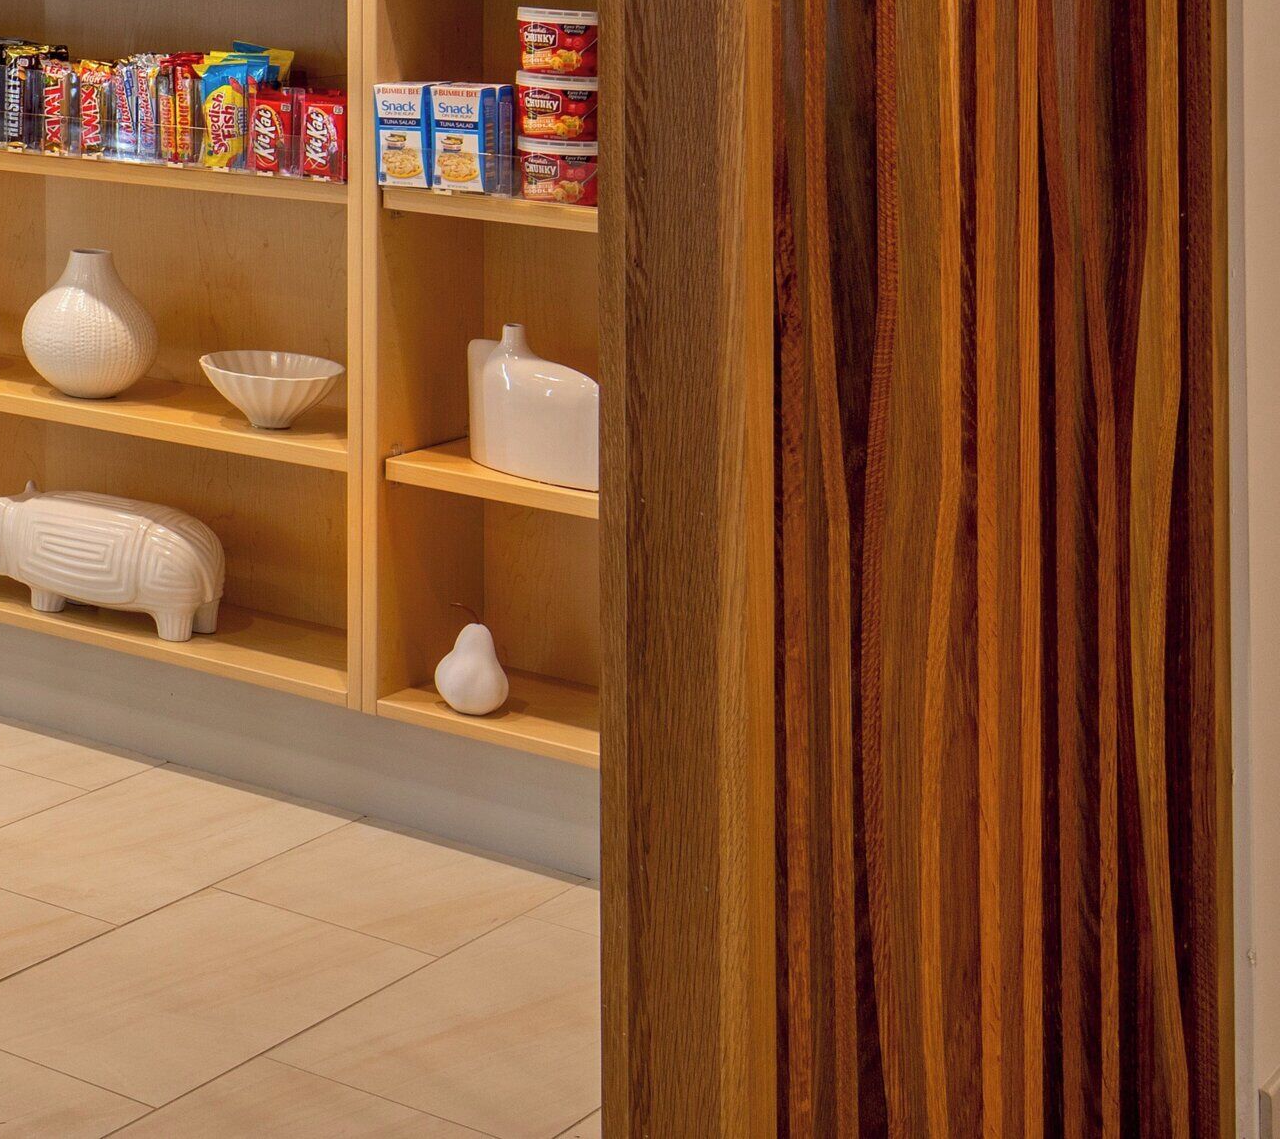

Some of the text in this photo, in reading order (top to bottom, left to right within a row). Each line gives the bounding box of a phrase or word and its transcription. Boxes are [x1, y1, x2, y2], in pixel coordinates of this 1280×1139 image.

[524, 32, 556, 45] CHUNKY
[381, 87, 420, 96] BUMBLE BEE
[438, 89, 478, 98] BUMBLE BEE
[43, 77, 66, 143] TWIX
[381, 100, 416, 112] Snack
[438, 102, 473, 115] Snack
[525, 97, 559, 110] CHUNKY
[81, 85, 102, 145] TWIX
[209, 92, 229, 155] Swedish
[221, 104, 237, 140] Fish
[524, 162, 557, 175] CHUNKY
